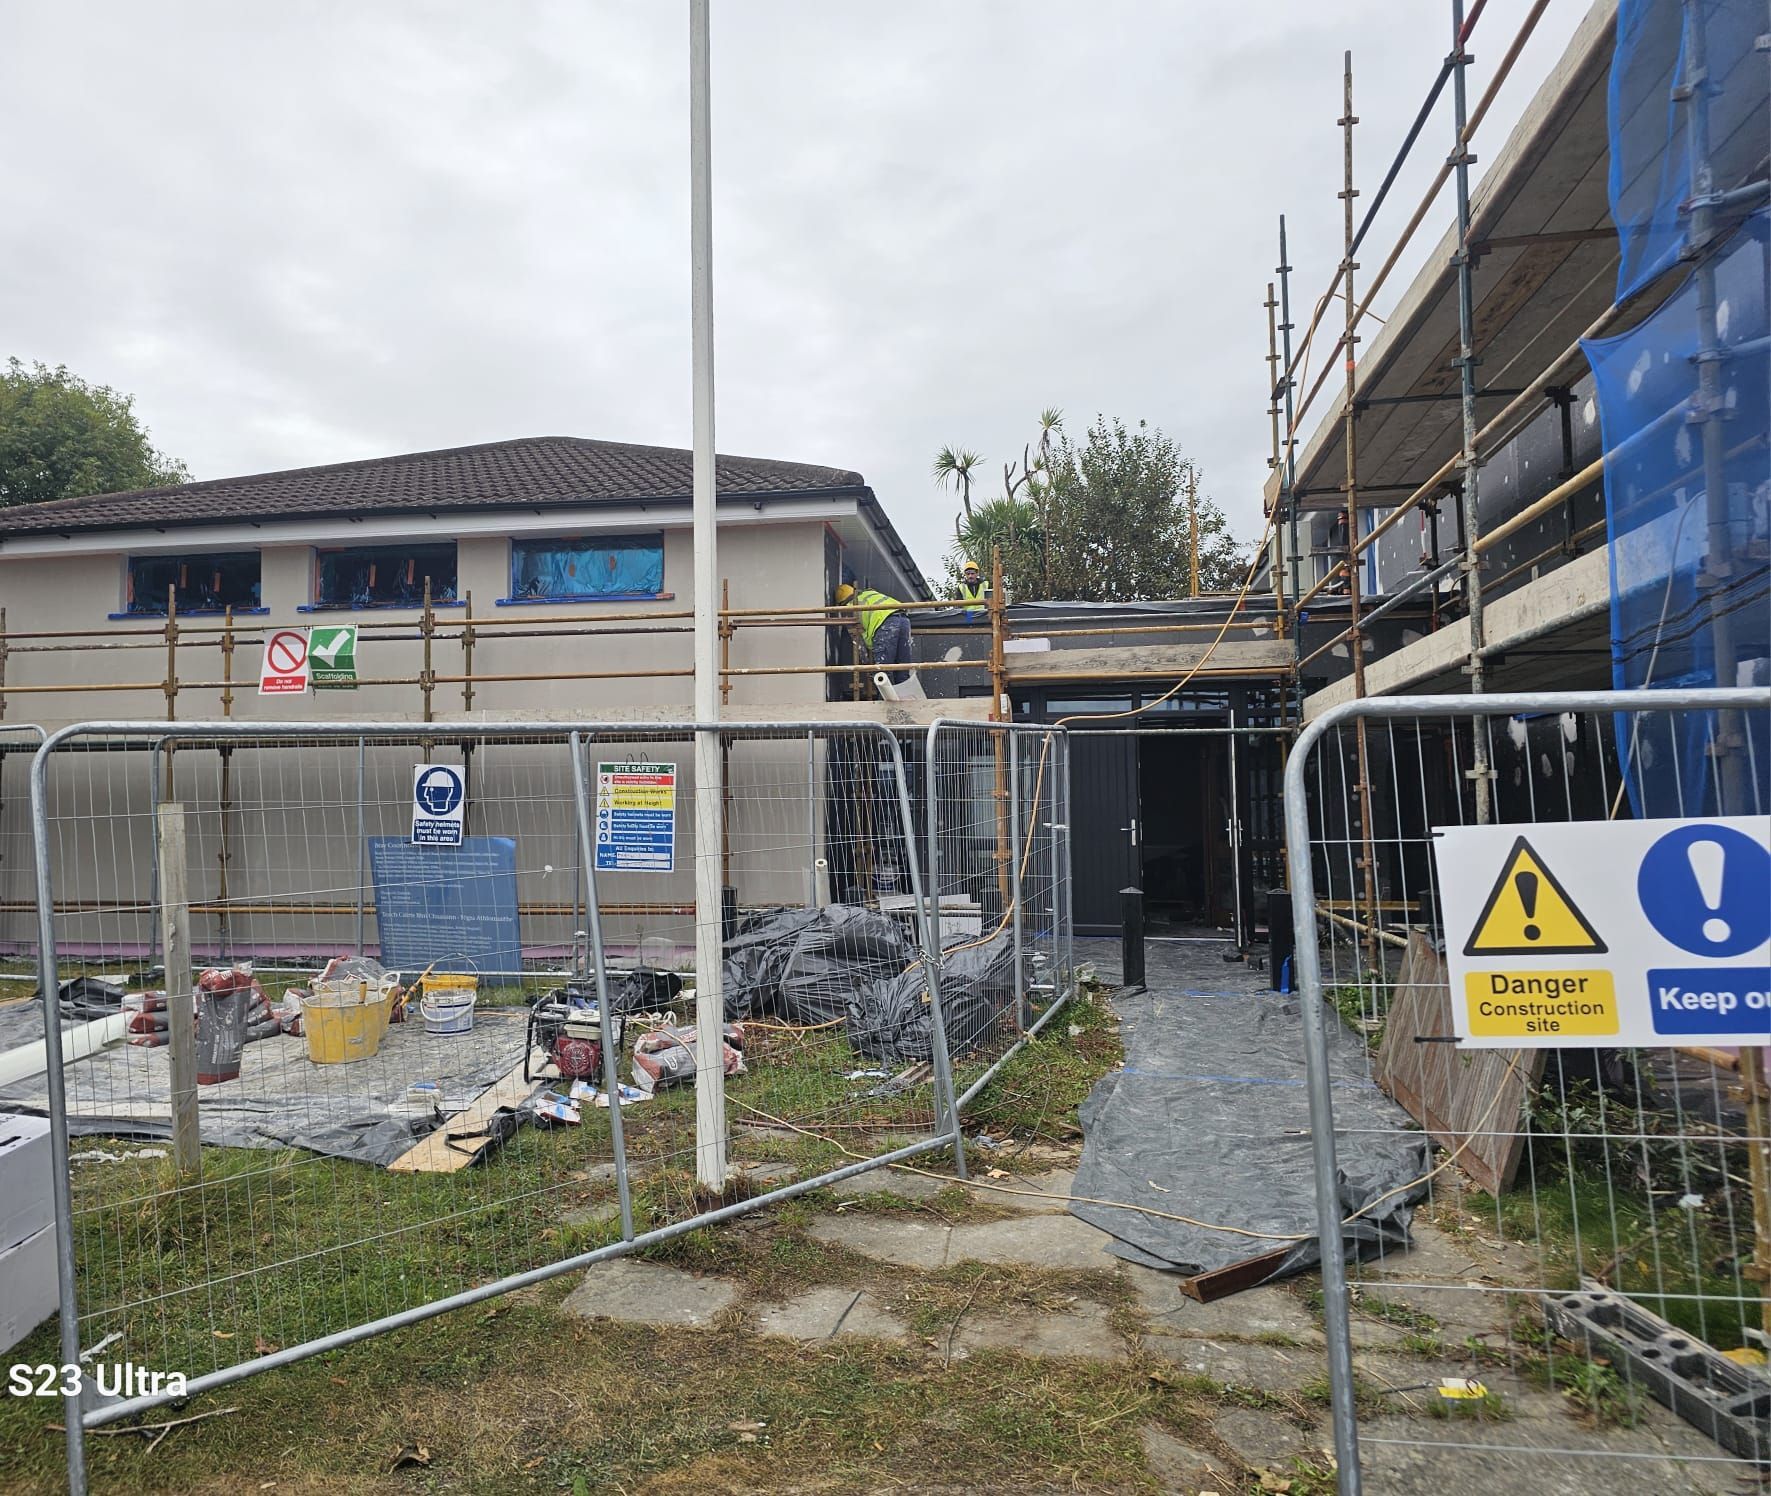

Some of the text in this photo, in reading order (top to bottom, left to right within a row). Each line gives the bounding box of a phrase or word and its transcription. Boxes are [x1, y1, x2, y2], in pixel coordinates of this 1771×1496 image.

[316, 673, 353, 681] Scaffolding
[614, 765, 660, 773] SITE SAFETY
[1490, 974, 1589, 998] Danger
[1658, 986, 1738, 1015] Keep
[1479, 1001, 1604, 1016] Construction
[1526, 1018, 1561, 1032] site
